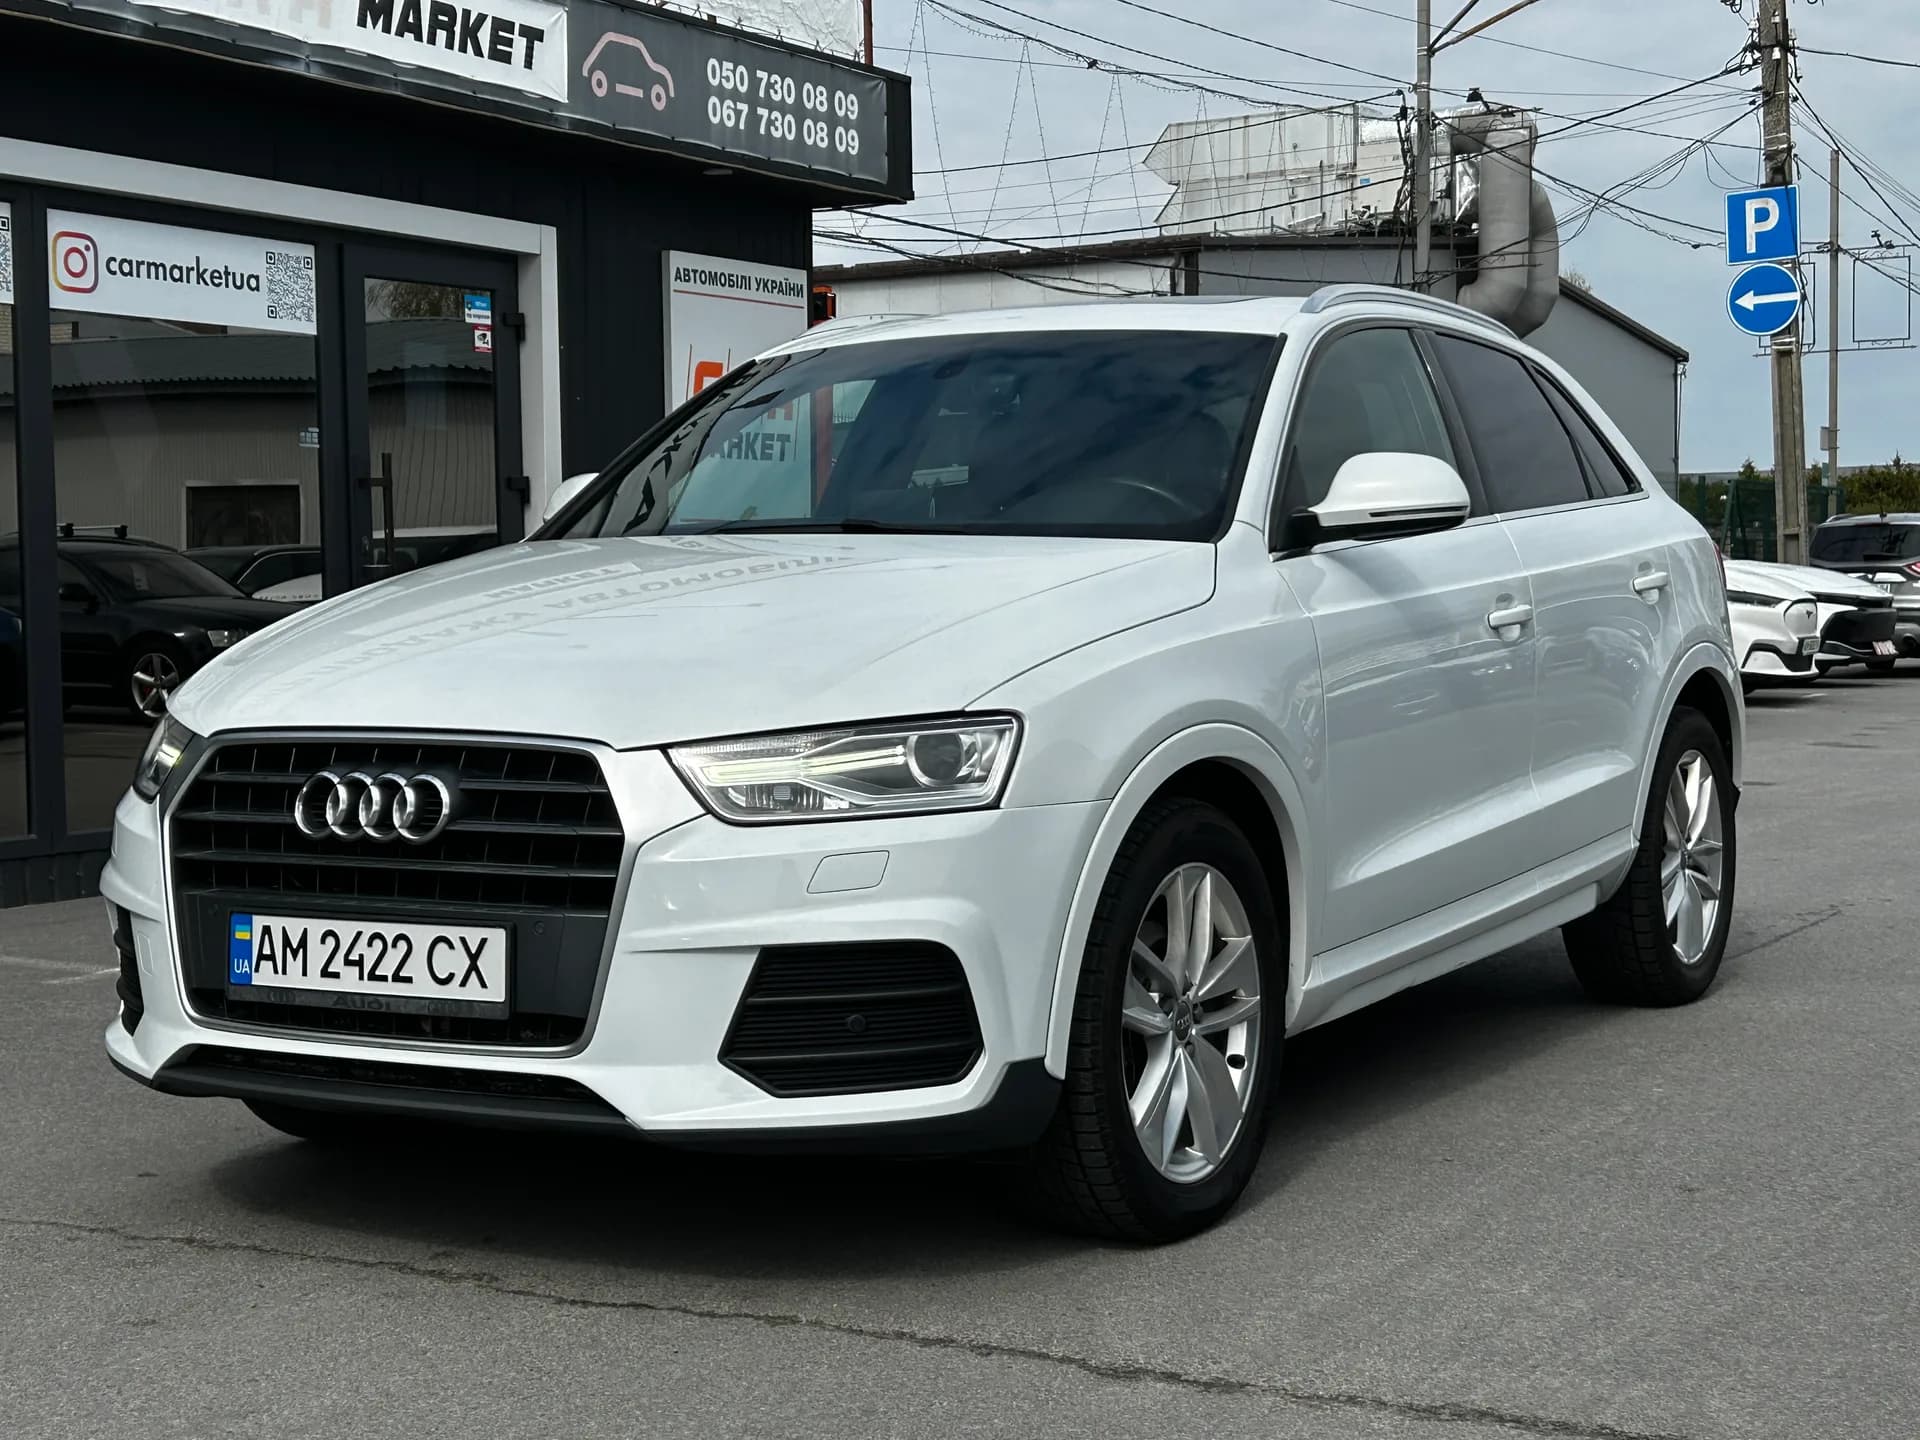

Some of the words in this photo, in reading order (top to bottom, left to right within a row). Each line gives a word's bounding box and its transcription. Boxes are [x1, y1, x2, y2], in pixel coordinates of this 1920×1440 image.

[356, 0, 545, 70] MARKET
[707, 57, 749, 93] 050
[756, 69, 796, 105] 730
[802, 82, 828, 112] 08
[834, 90, 859, 120] 09
[707, 95, 749, 130] 067
[756, 107, 796, 141] 730
[802, 118, 829, 148] 08
[834, 126, 859, 155] 09
[1745, 197, 1780, 254] P
[105, 256, 261, 292] carmarketua
[674, 266, 752, 291] АВТОМОБІЛІ
[755, 277, 804, 298] УКРАЇНИ
[710, 431, 792, 463] RKET
[234, 957, 250, 974] UA
[253, 924, 308, 977] AM
[320, 929, 414, 984] 2422
[426, 935, 489, 990] CX
